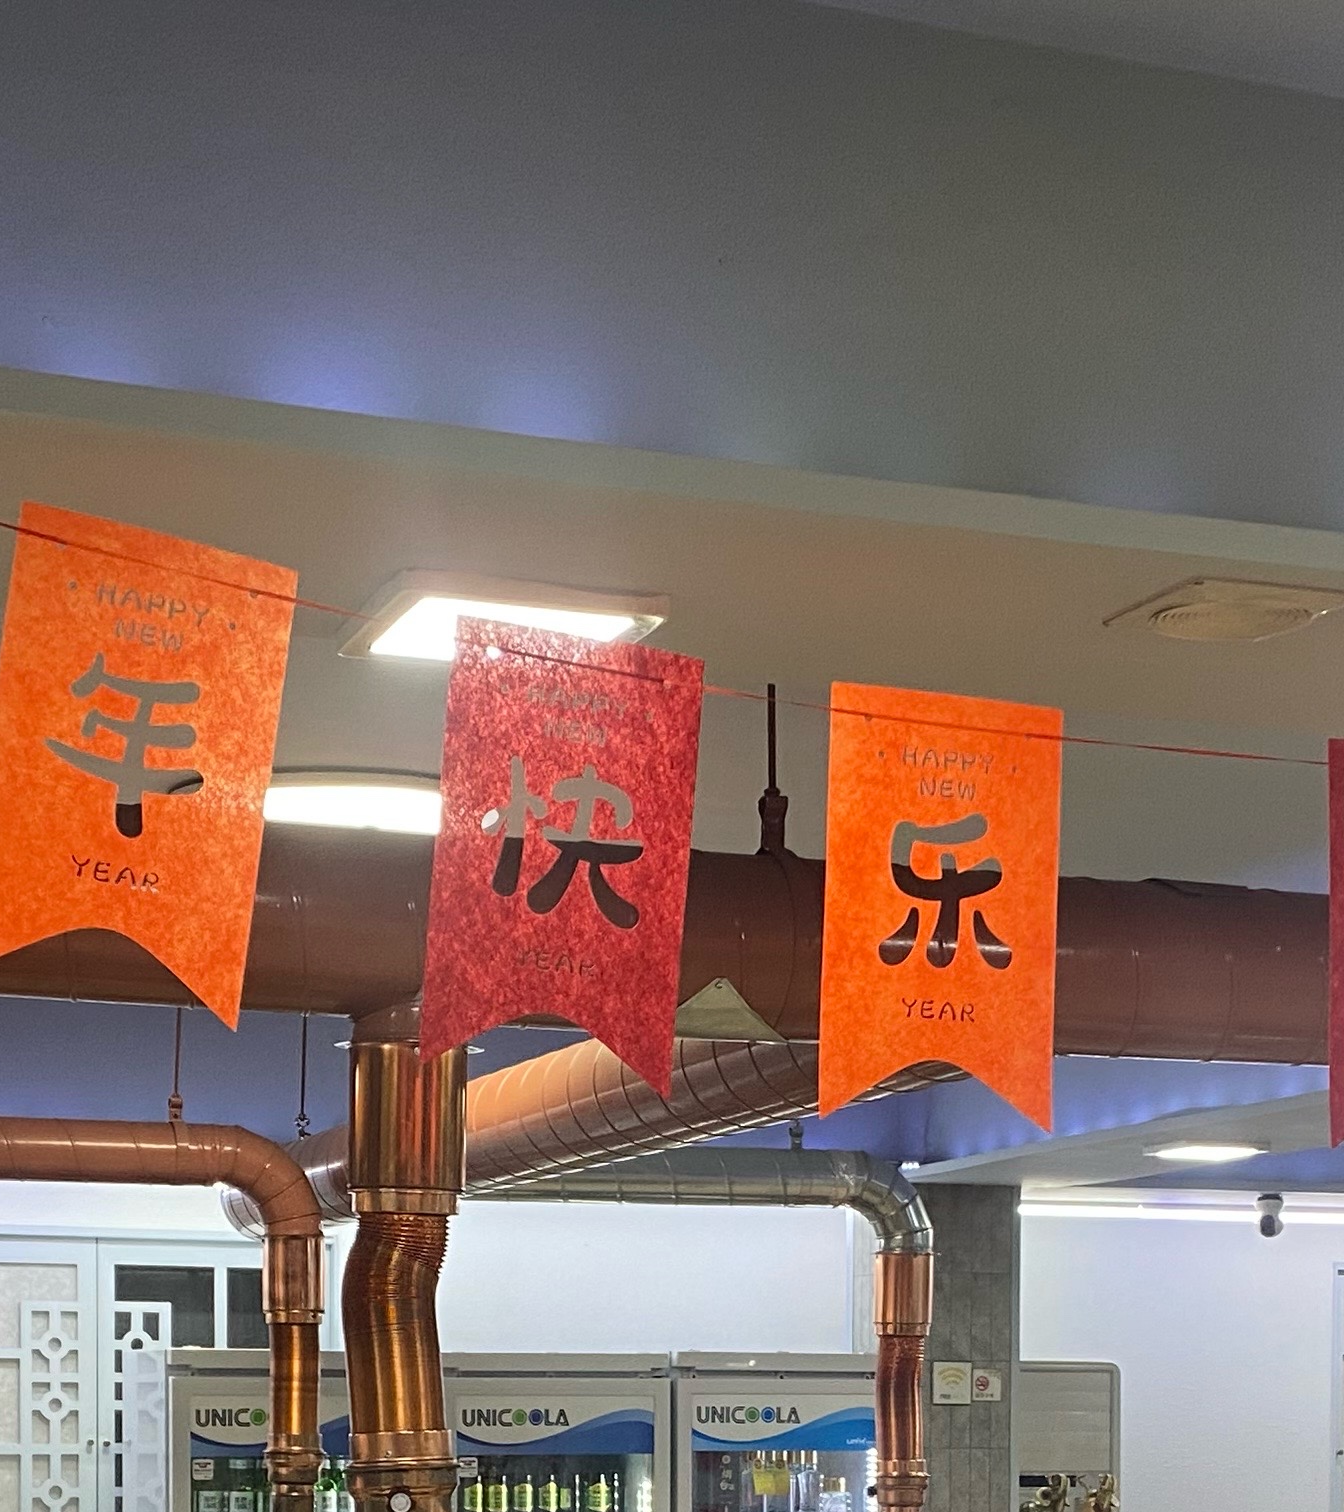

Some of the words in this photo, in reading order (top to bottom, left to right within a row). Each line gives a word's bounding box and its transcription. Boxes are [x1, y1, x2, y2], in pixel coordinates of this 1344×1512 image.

[96, 582, 210, 628] HAPPY
[115, 618, 185, 653] NEW
[44, 652, 205, 839] 年
[902, 745, 995, 775] HAPPY
[919, 779, 977, 801] NEW
[481, 754, 644, 930] 快
[71, 854, 161, 892] YEAR
[878, 813, 1013, 970] 乐
[900, 997, 976, 1023] YEAR
[195, 1408, 269, 1428] UNICO
[461, 1408, 570, 1428] UNICOOLA
[696, 1405, 801, 1424] UNICOOLA
